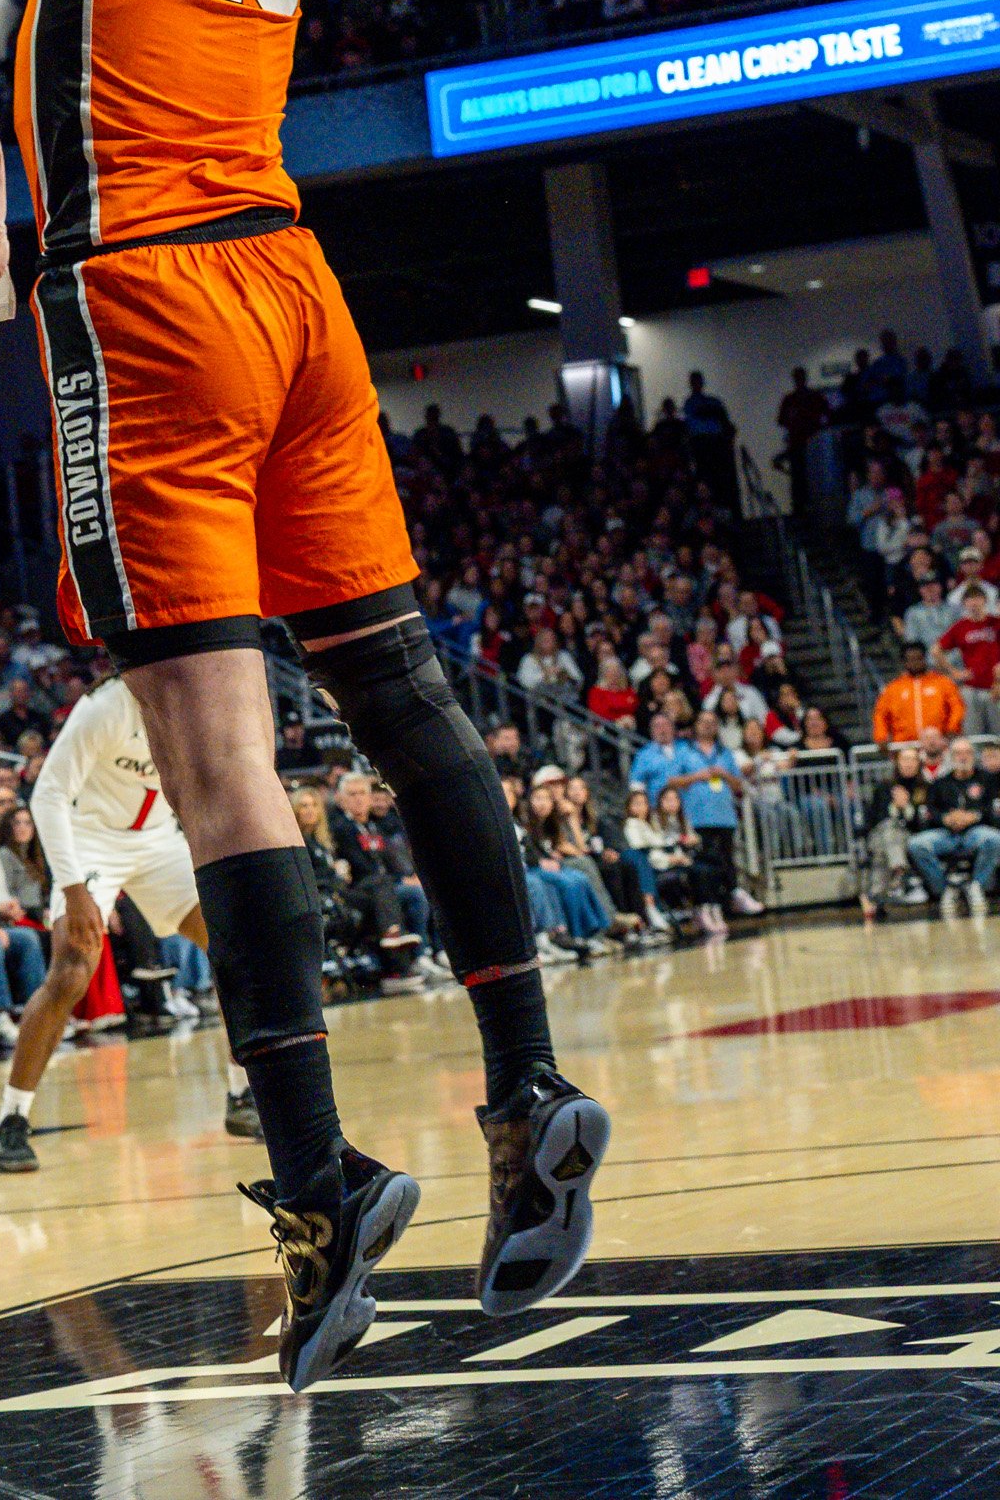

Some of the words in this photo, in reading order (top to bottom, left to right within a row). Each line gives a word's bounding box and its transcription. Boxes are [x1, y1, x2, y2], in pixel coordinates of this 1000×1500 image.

[638, 70, 653, 93] A
[657, 49, 742, 95] CLEAN
[744, 37, 819, 80] CRISP
[820, 24, 903, 67] TASTE
[57, 370, 103, 547] COWBOYS
